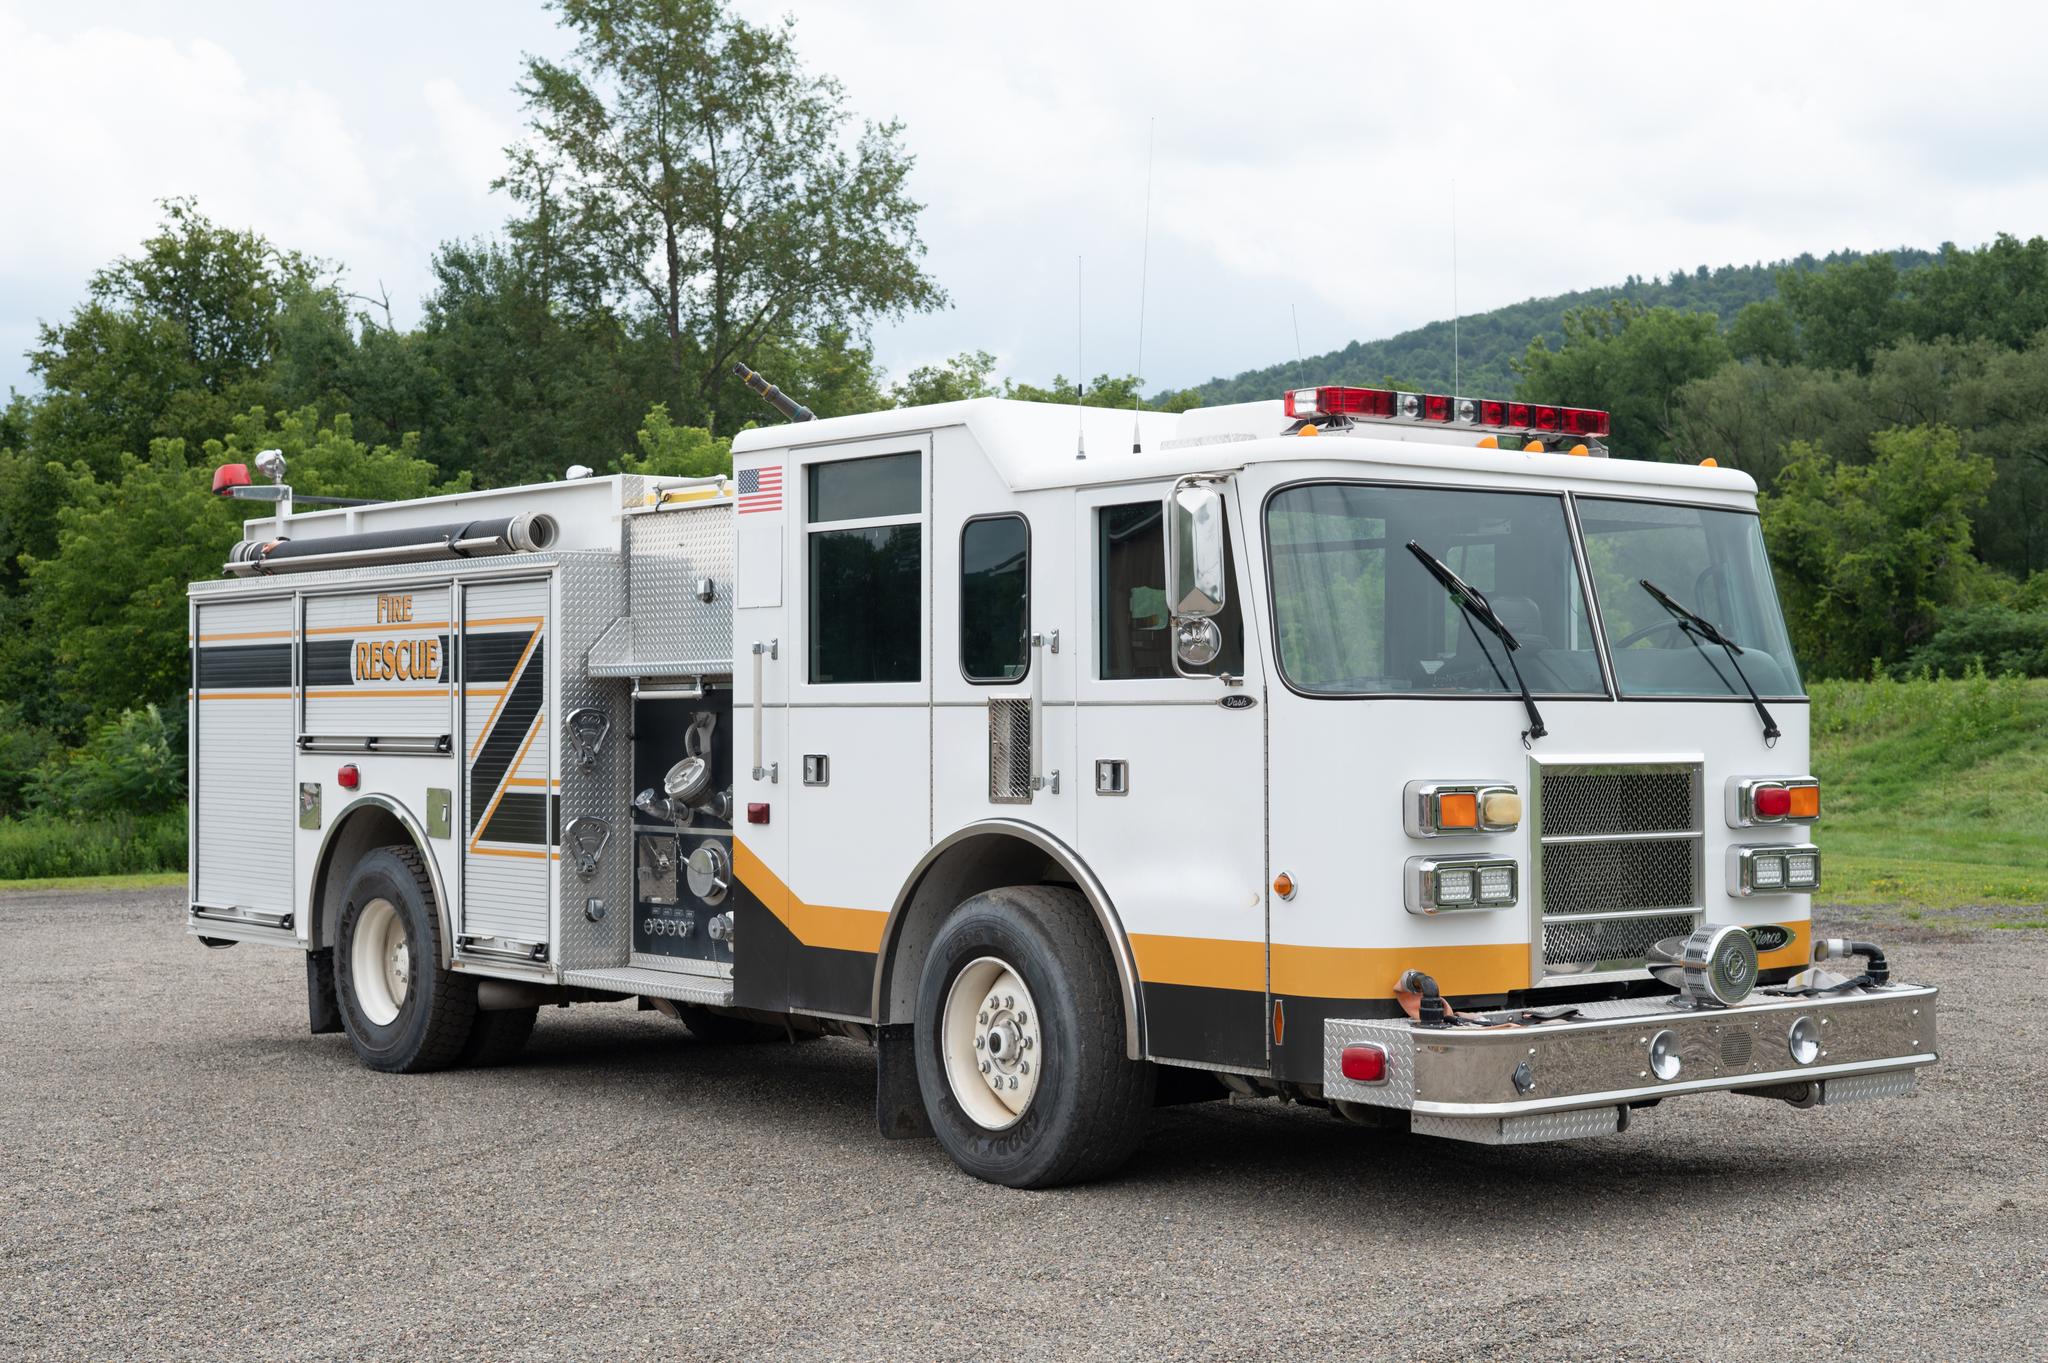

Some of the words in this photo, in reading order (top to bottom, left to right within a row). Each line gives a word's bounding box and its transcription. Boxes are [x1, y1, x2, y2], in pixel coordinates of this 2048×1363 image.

[377, 593, 413, 623] FIRE
[356, 639, 439, 681] RESCUE
[1227, 697, 1247, 707] Dash
[1748, 928, 1782, 945] Pierce
